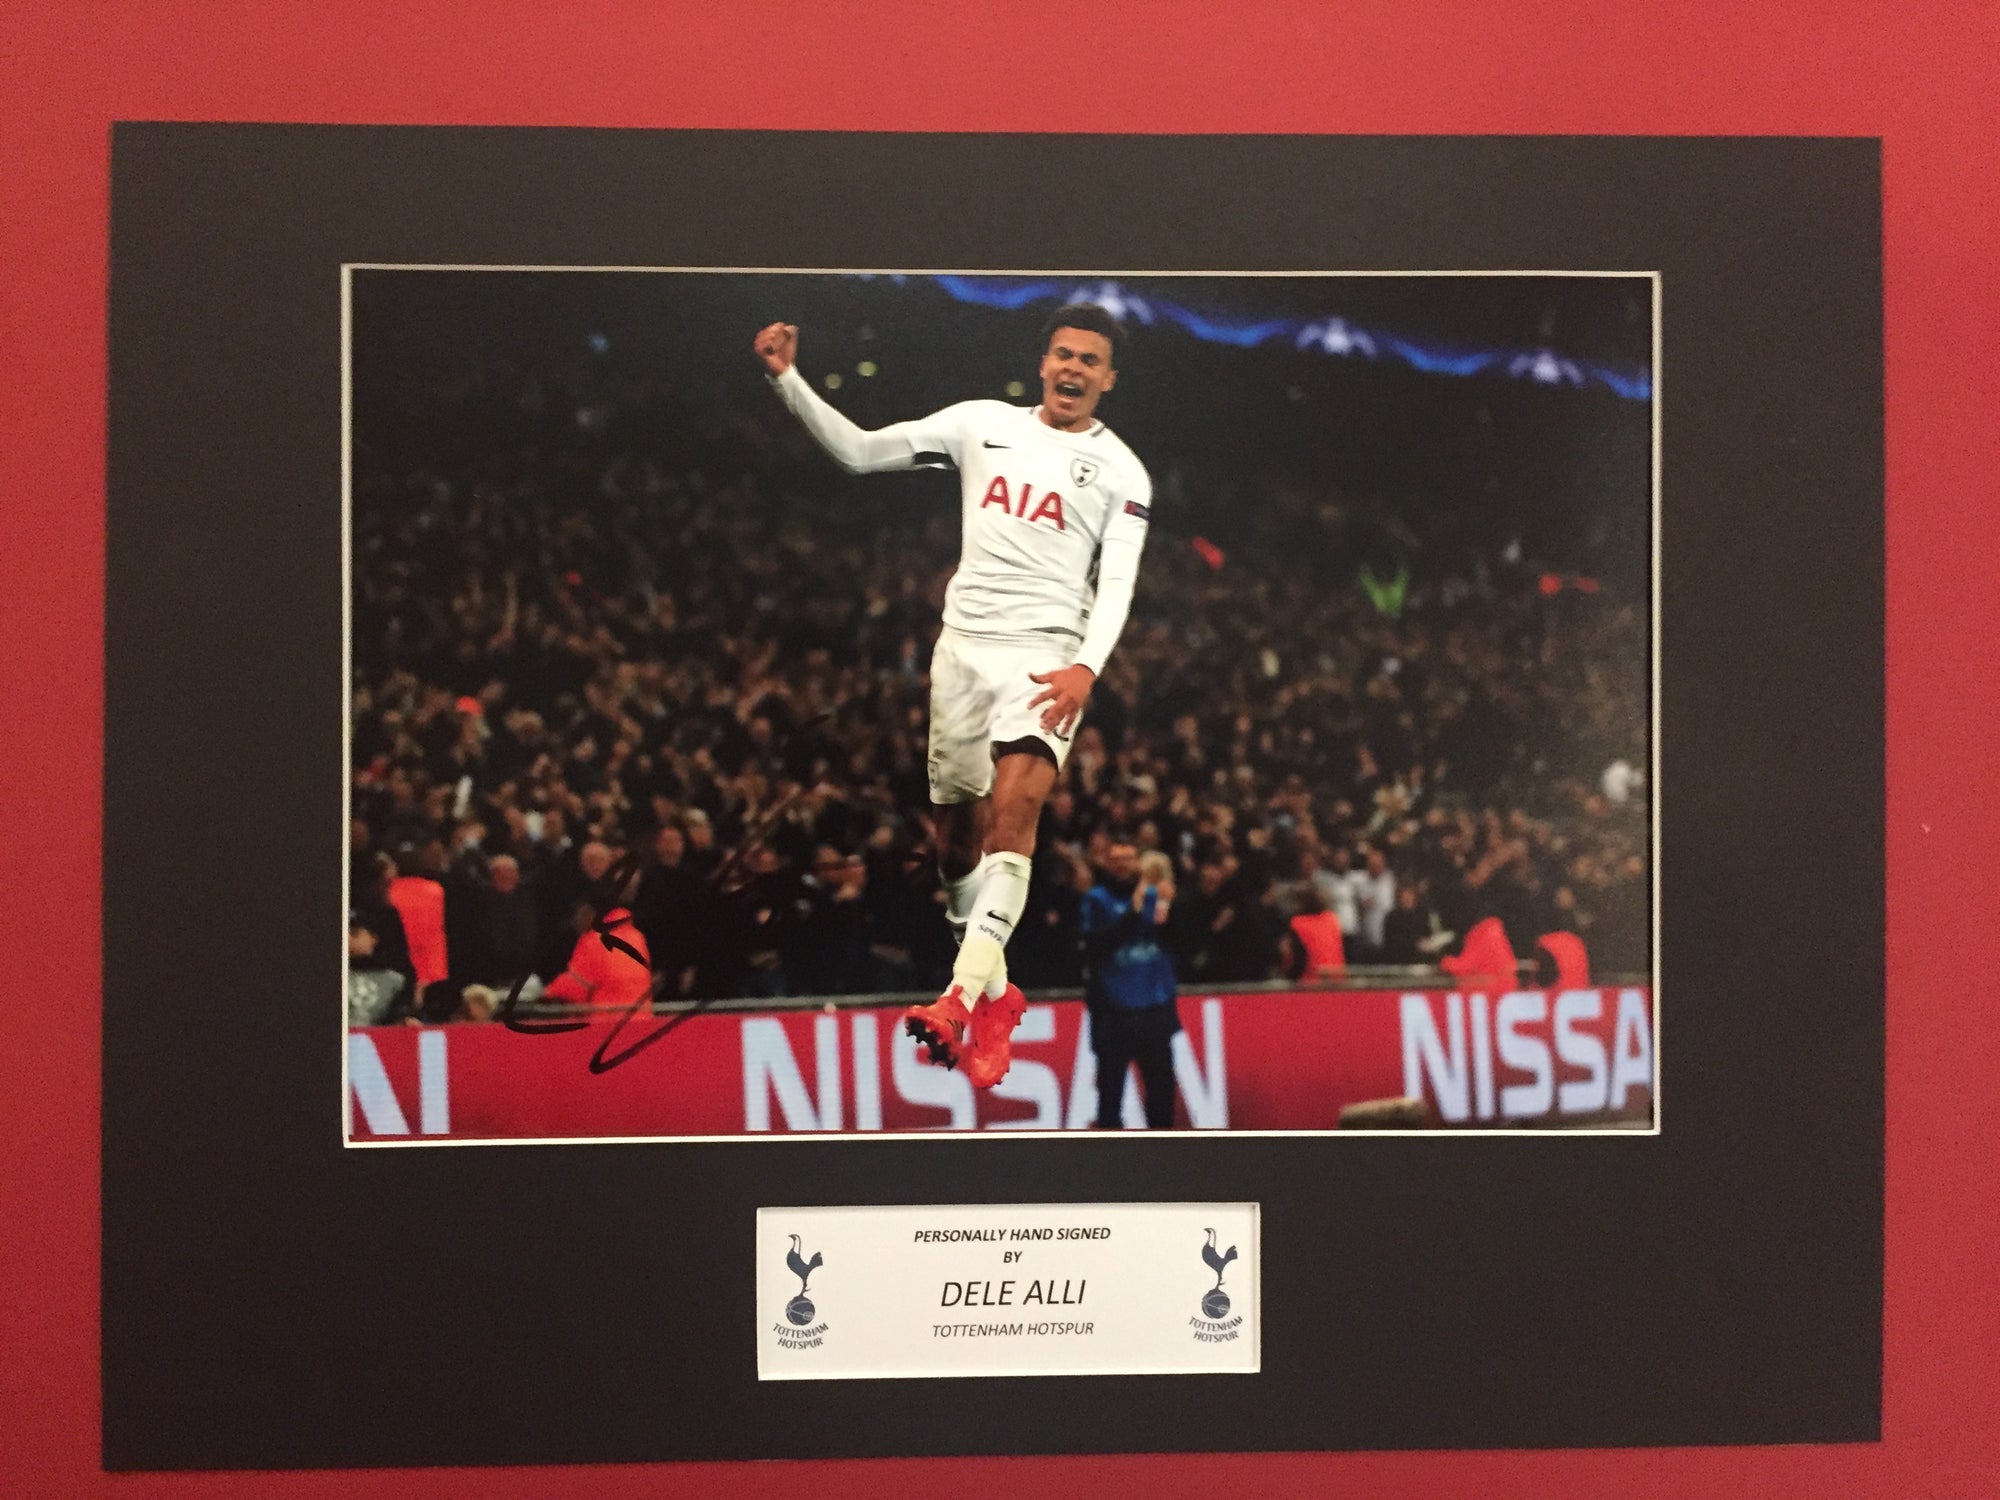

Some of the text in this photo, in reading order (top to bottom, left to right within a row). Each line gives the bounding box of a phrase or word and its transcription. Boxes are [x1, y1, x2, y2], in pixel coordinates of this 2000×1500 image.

[980, 475, 1066, 531] AIA
[914, 1227, 1112, 1242] PERSONALLY HAND SIGNED
[1003, 1251, 1023, 1264] BY
[941, 1279, 1087, 1307] DELE ALLI
[772, 1323, 829, 1339] TOTTENHAM
[932, 1321, 1095, 1338] TOTTENHAM HOTSPUR
[1188, 1316, 1243, 1332] TOTTENHAM
[777, 1338, 823, 1349] HOTSPUR
[1193, 1331, 1239, 1343] HOTSPUR
